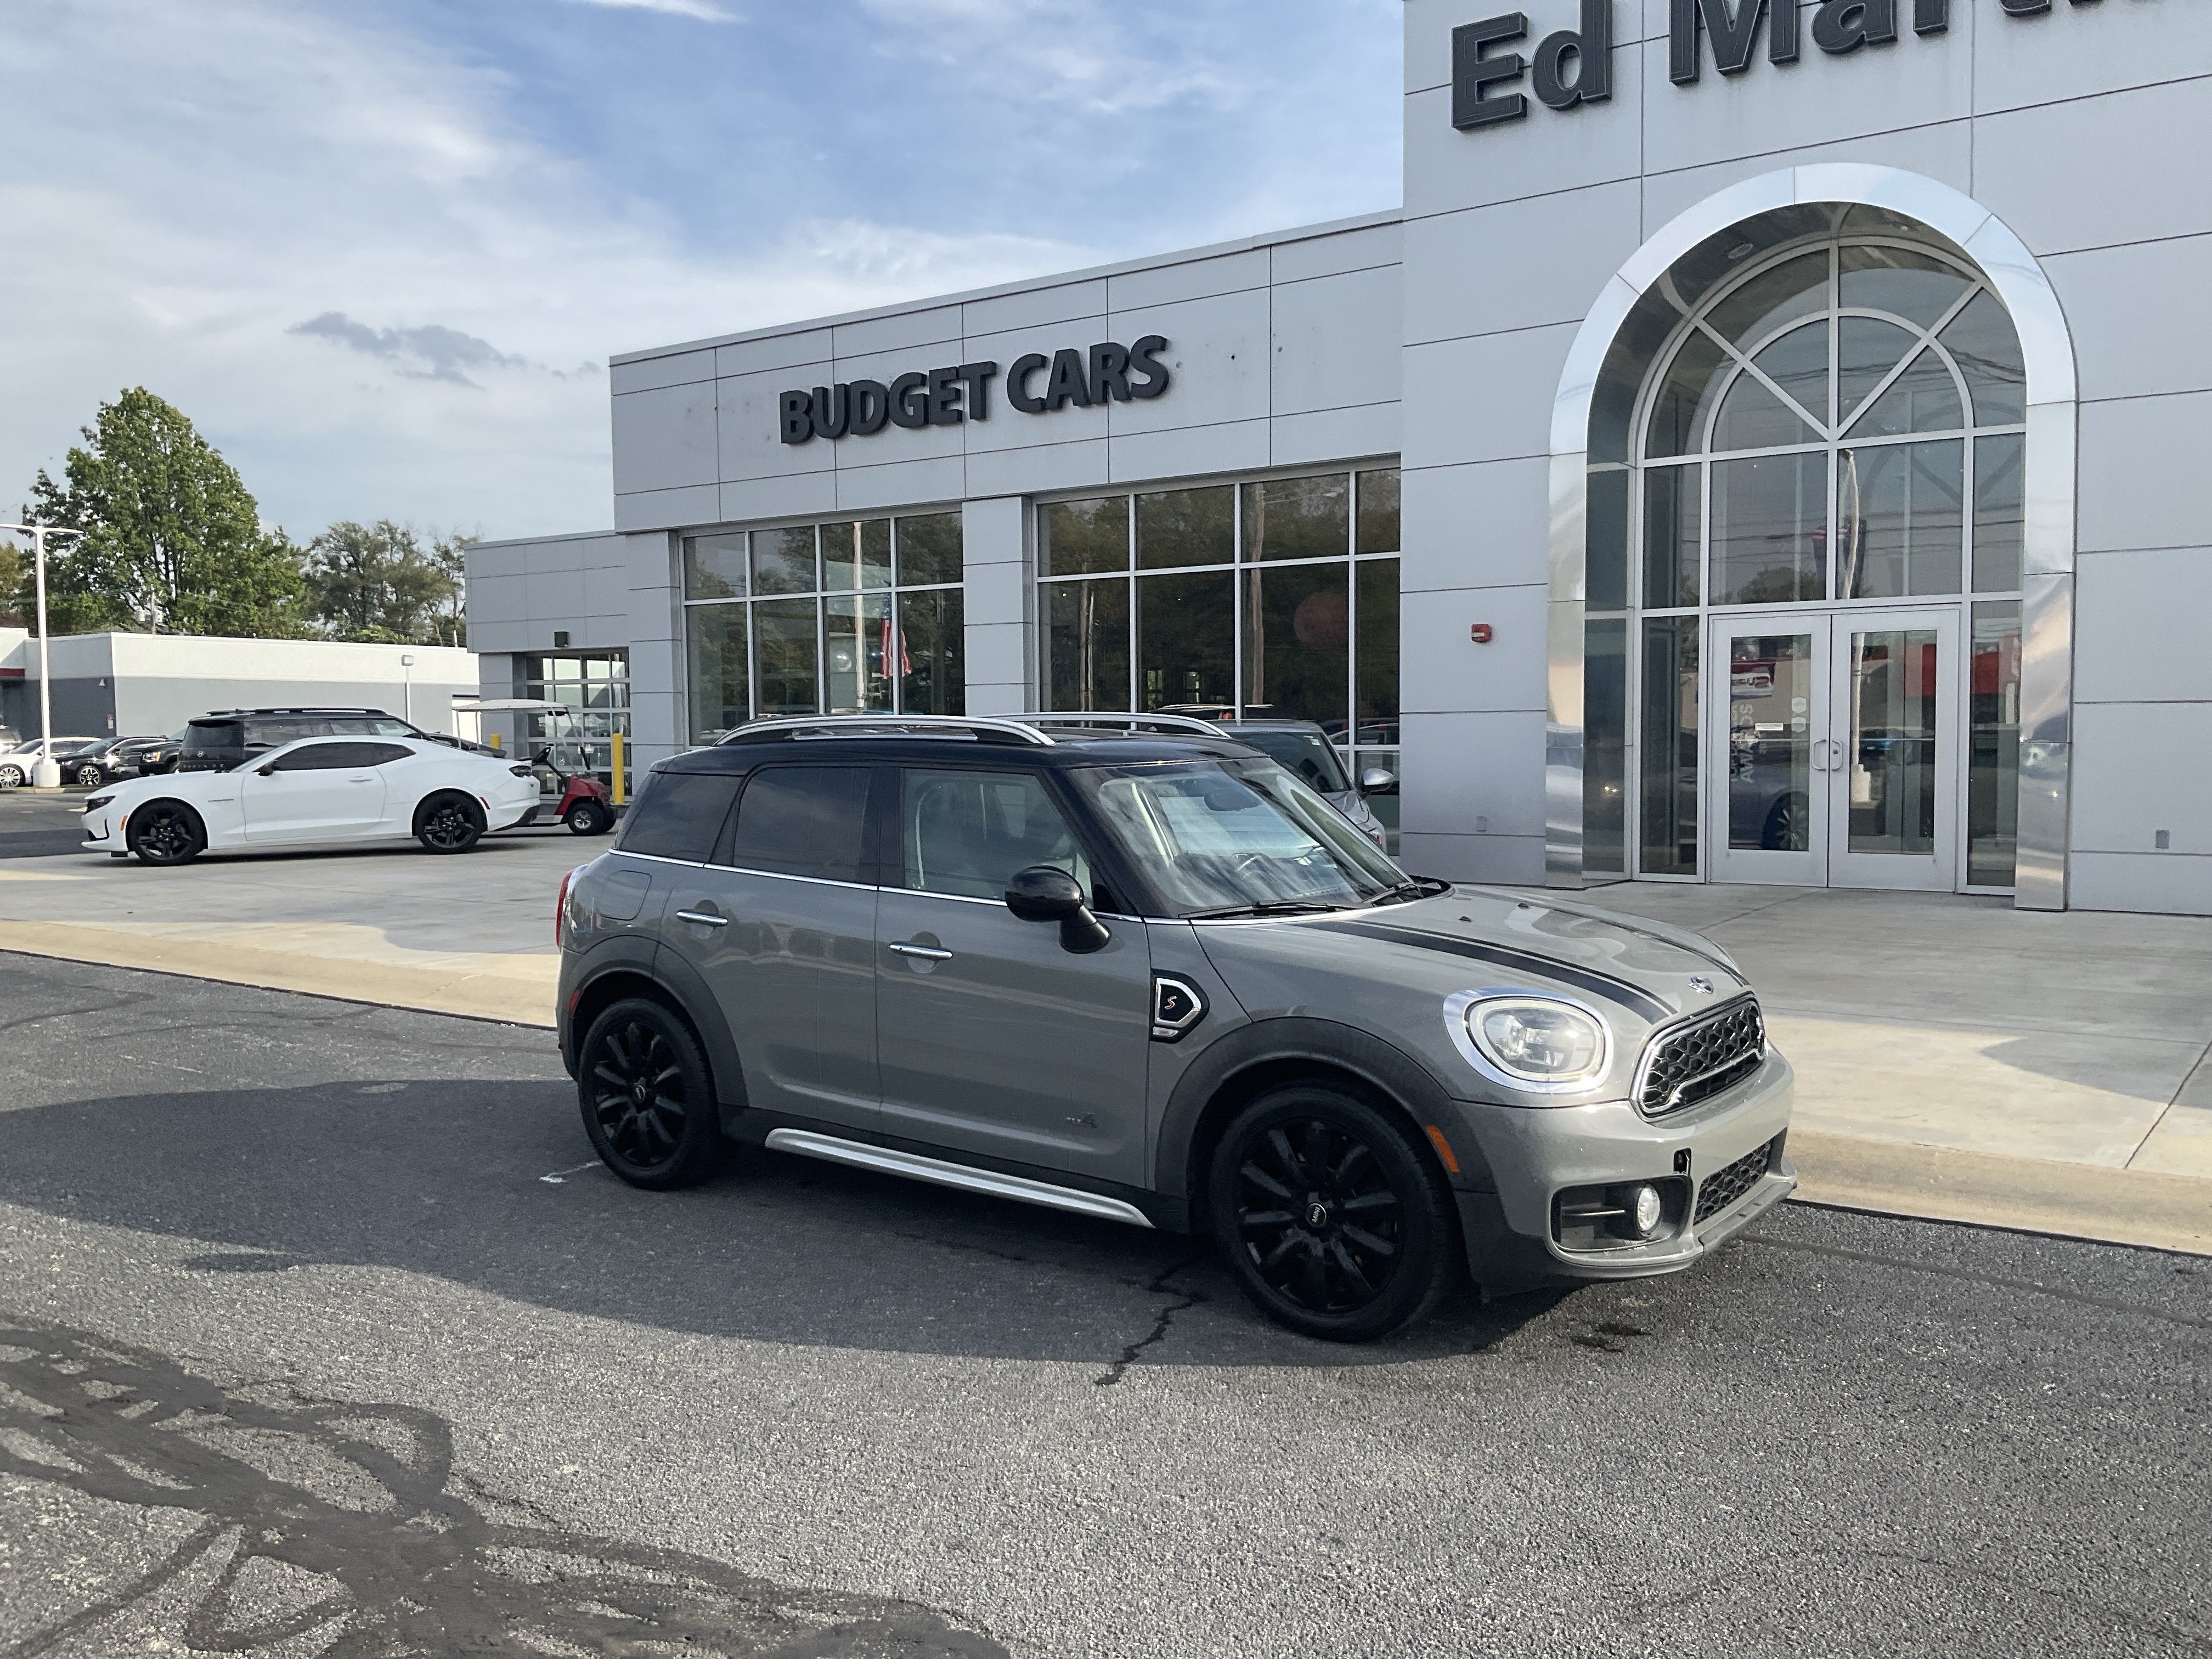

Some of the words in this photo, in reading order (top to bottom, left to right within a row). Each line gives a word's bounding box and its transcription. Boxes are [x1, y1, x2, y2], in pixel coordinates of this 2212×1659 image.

[1451, 0, 1612, 131] Ed
[780, 361, 997, 444] BUDGET
[1007, 335, 1169, 413] CARS
[1740, 703, 1754, 783] AWADS
[1165, 996, 1177, 1010] S
[1312, 1206, 1321, 1223] MINI
